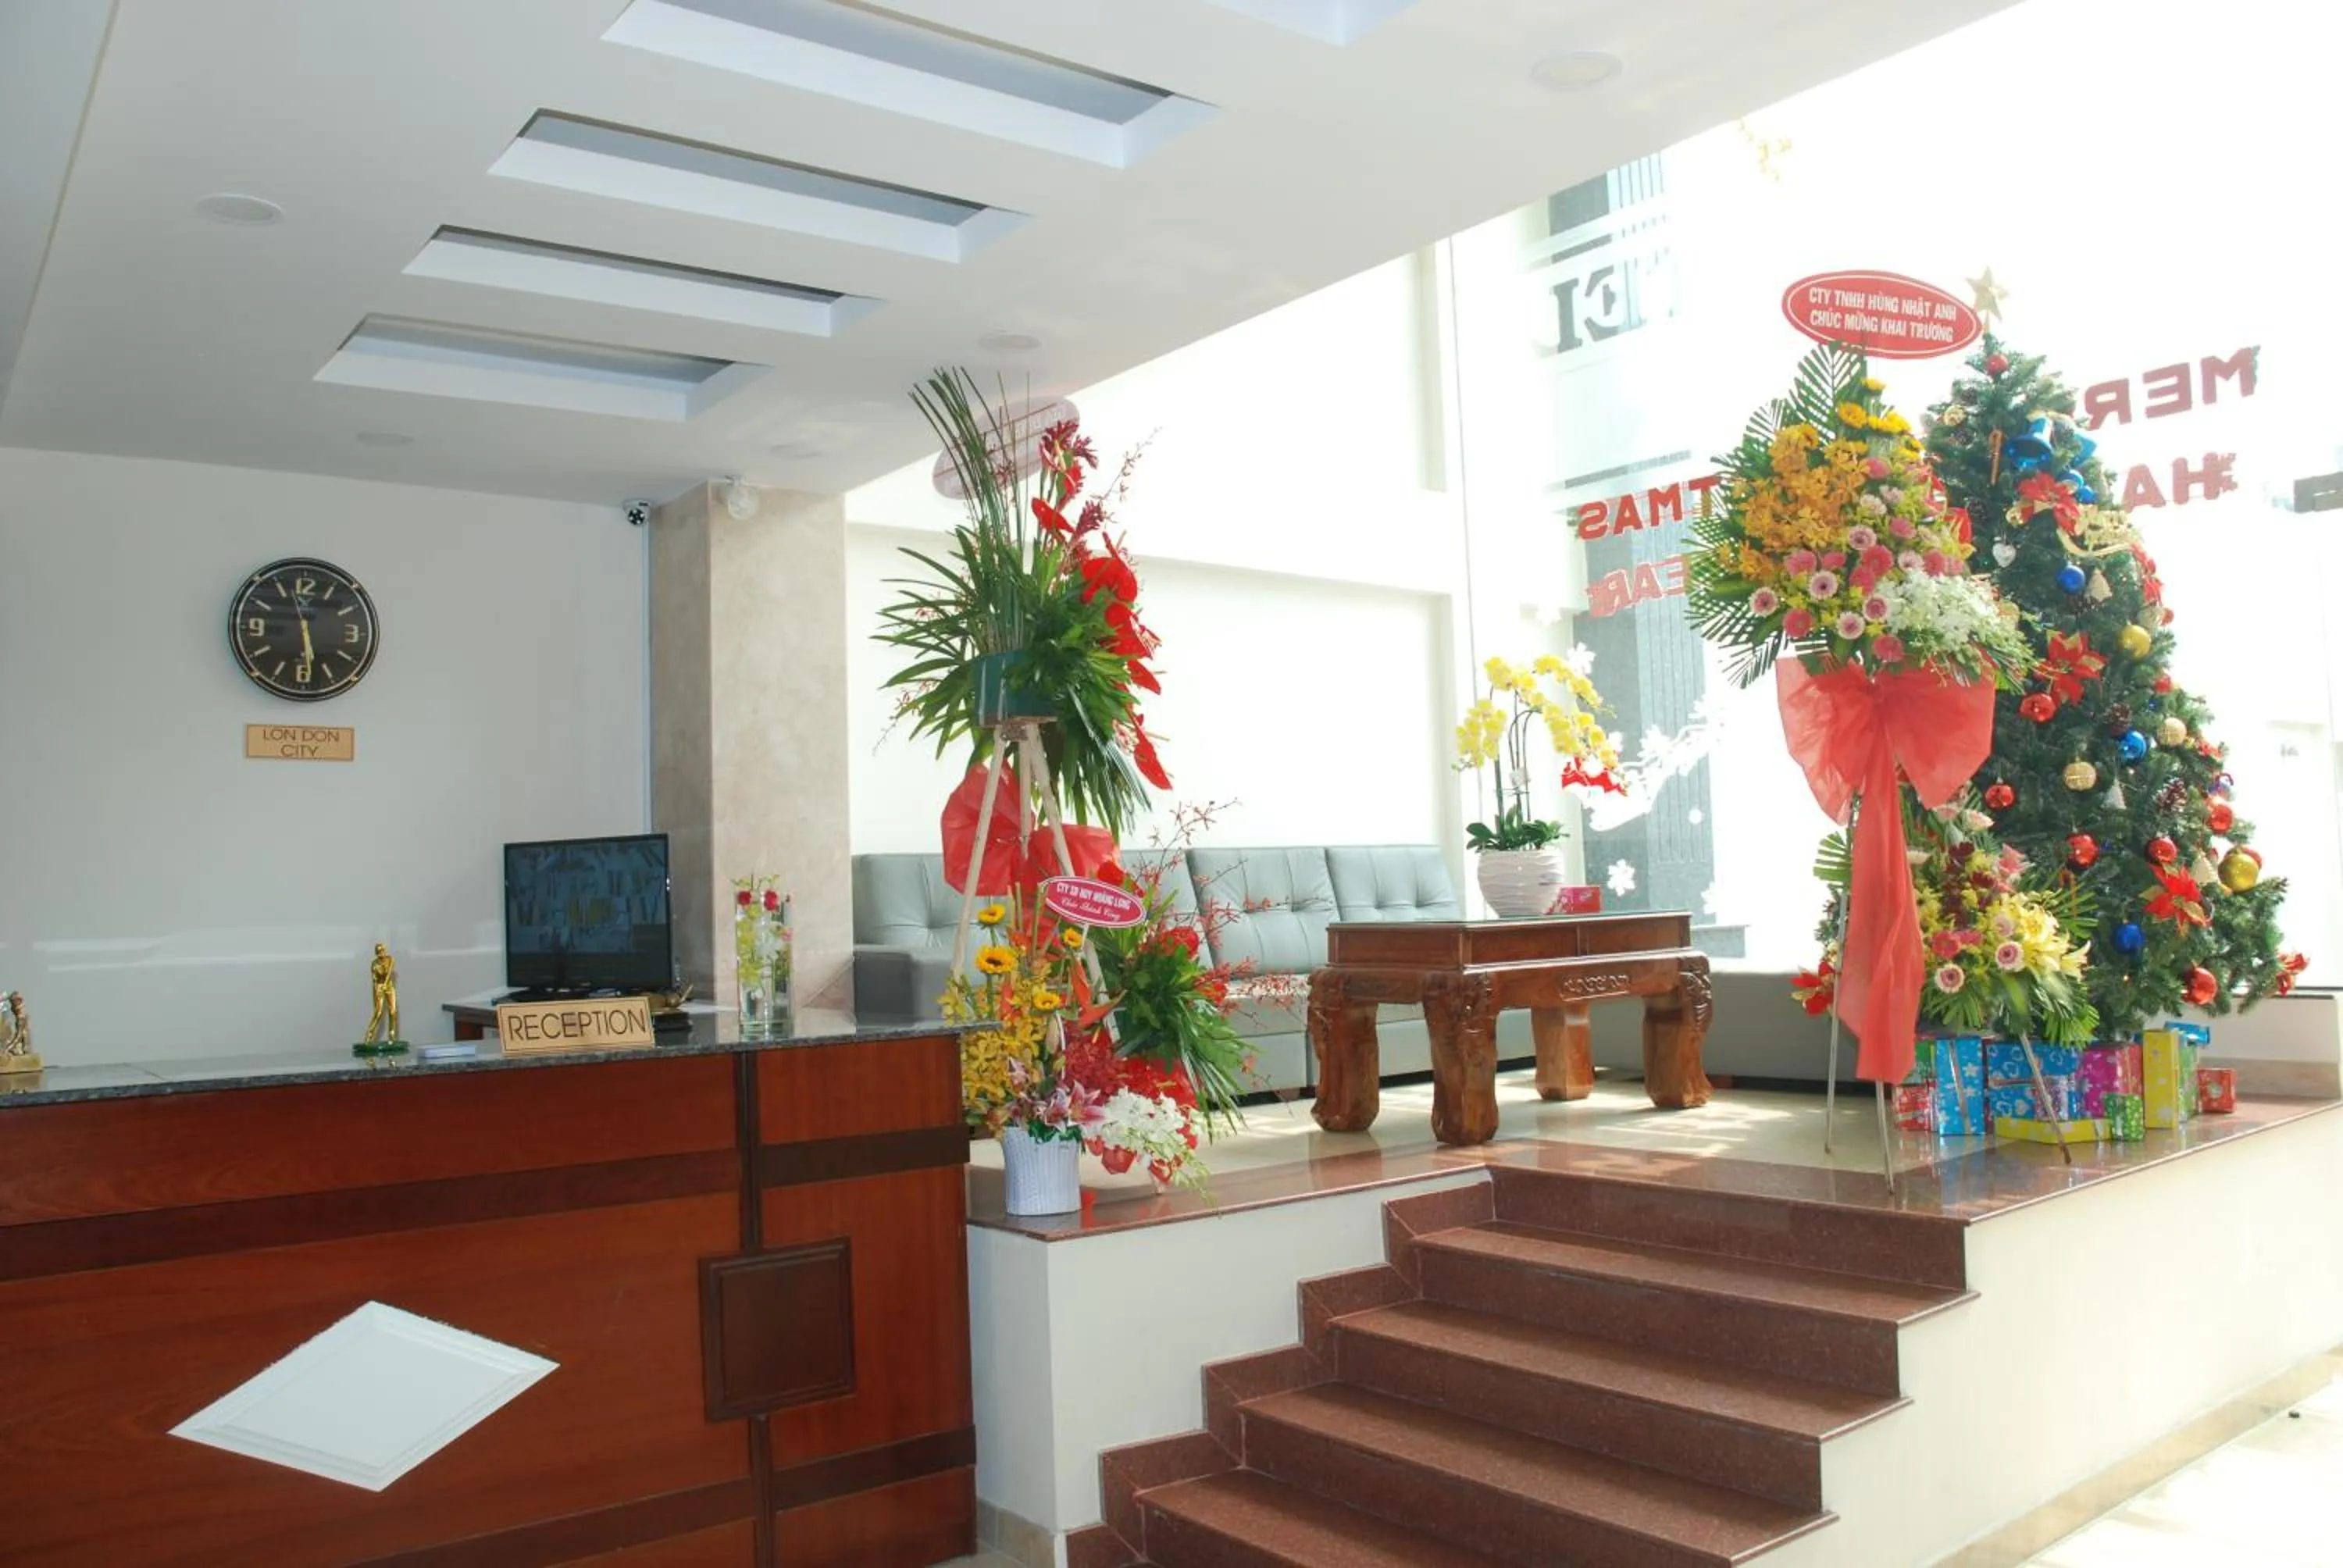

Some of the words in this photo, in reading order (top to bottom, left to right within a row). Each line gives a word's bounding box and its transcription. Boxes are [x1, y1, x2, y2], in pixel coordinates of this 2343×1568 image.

[1809, 287, 1832, 305] CTY
[1834, 290, 1865, 309] TNHH
[1901, 297, 1931, 319] NHẬT
[1934, 302, 1956, 322] ANH
[1810, 307, 1842, 329] CHÚC
[1845, 311, 1878, 333] MỪNG
[1881, 316, 1906, 337] KHAI
[295, 578, 316, 596] 12
[249, 618, 266, 636] 9
[344, 624, 359, 643] 3
[296, 665, 312, 683] 6
[280, 744, 319, 757] CITY
[508, 1009, 647, 1041] RECEPTION
